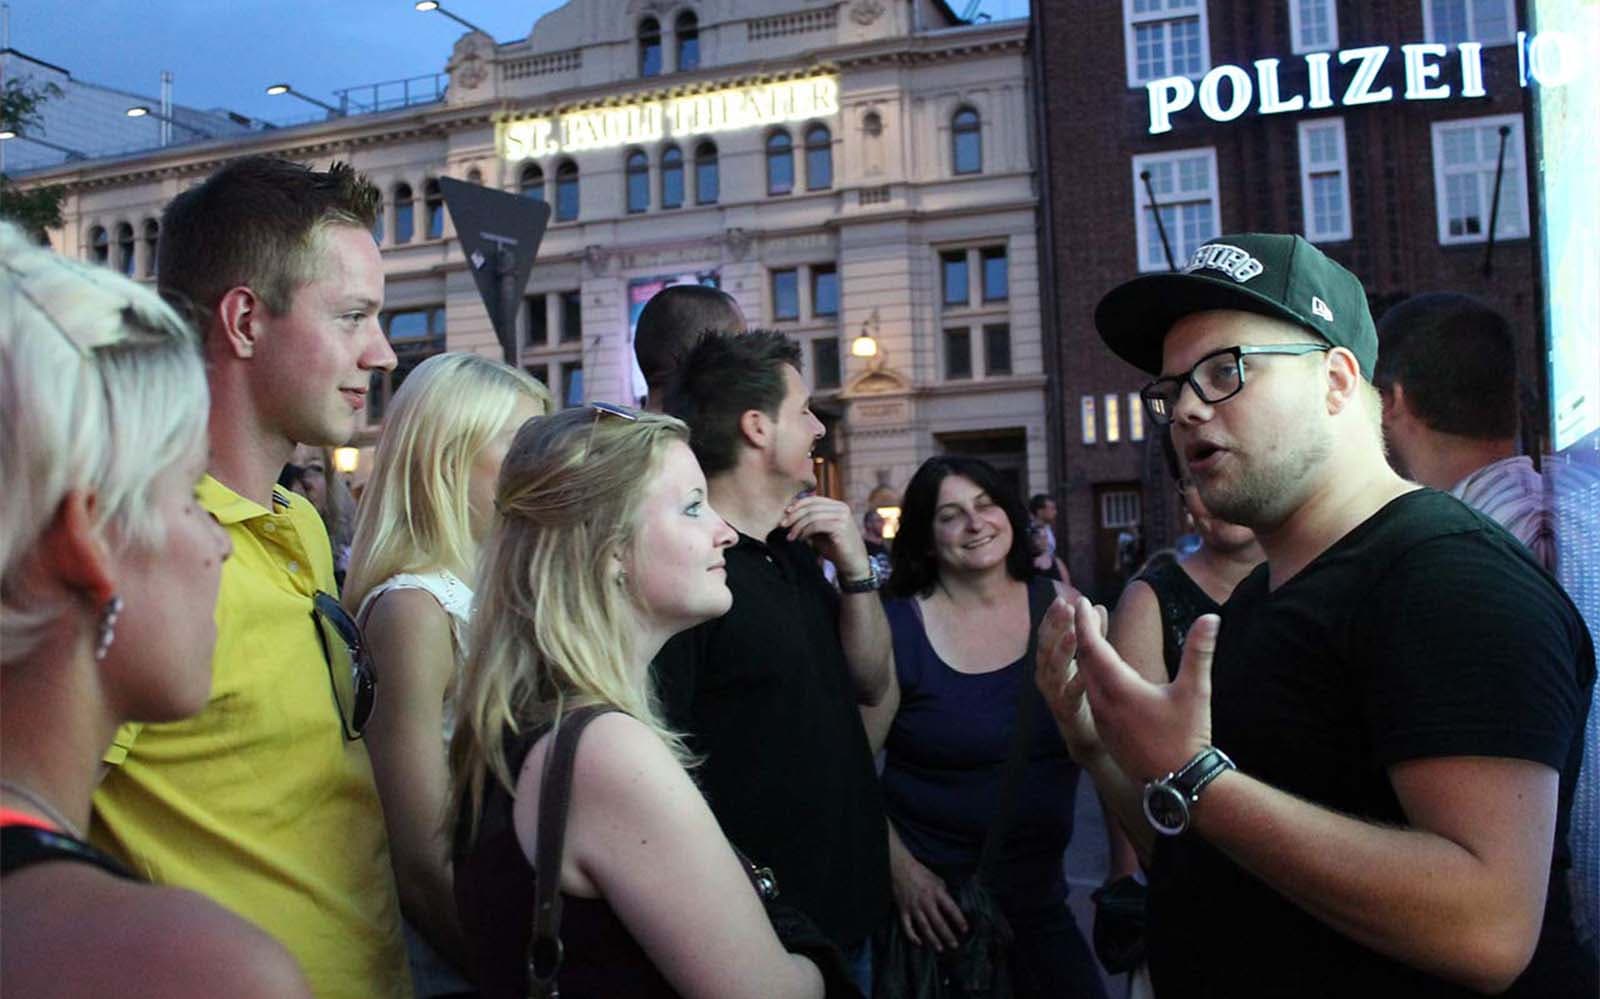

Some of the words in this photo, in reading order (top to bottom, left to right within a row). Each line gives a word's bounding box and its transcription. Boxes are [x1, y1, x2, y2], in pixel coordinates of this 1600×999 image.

[504, 118, 559, 161] ST.
[561, 103, 664, 153] PAULI
[666, 76, 838, 138] THEATER
[1146, 42, 1486, 134] POLIZEI
